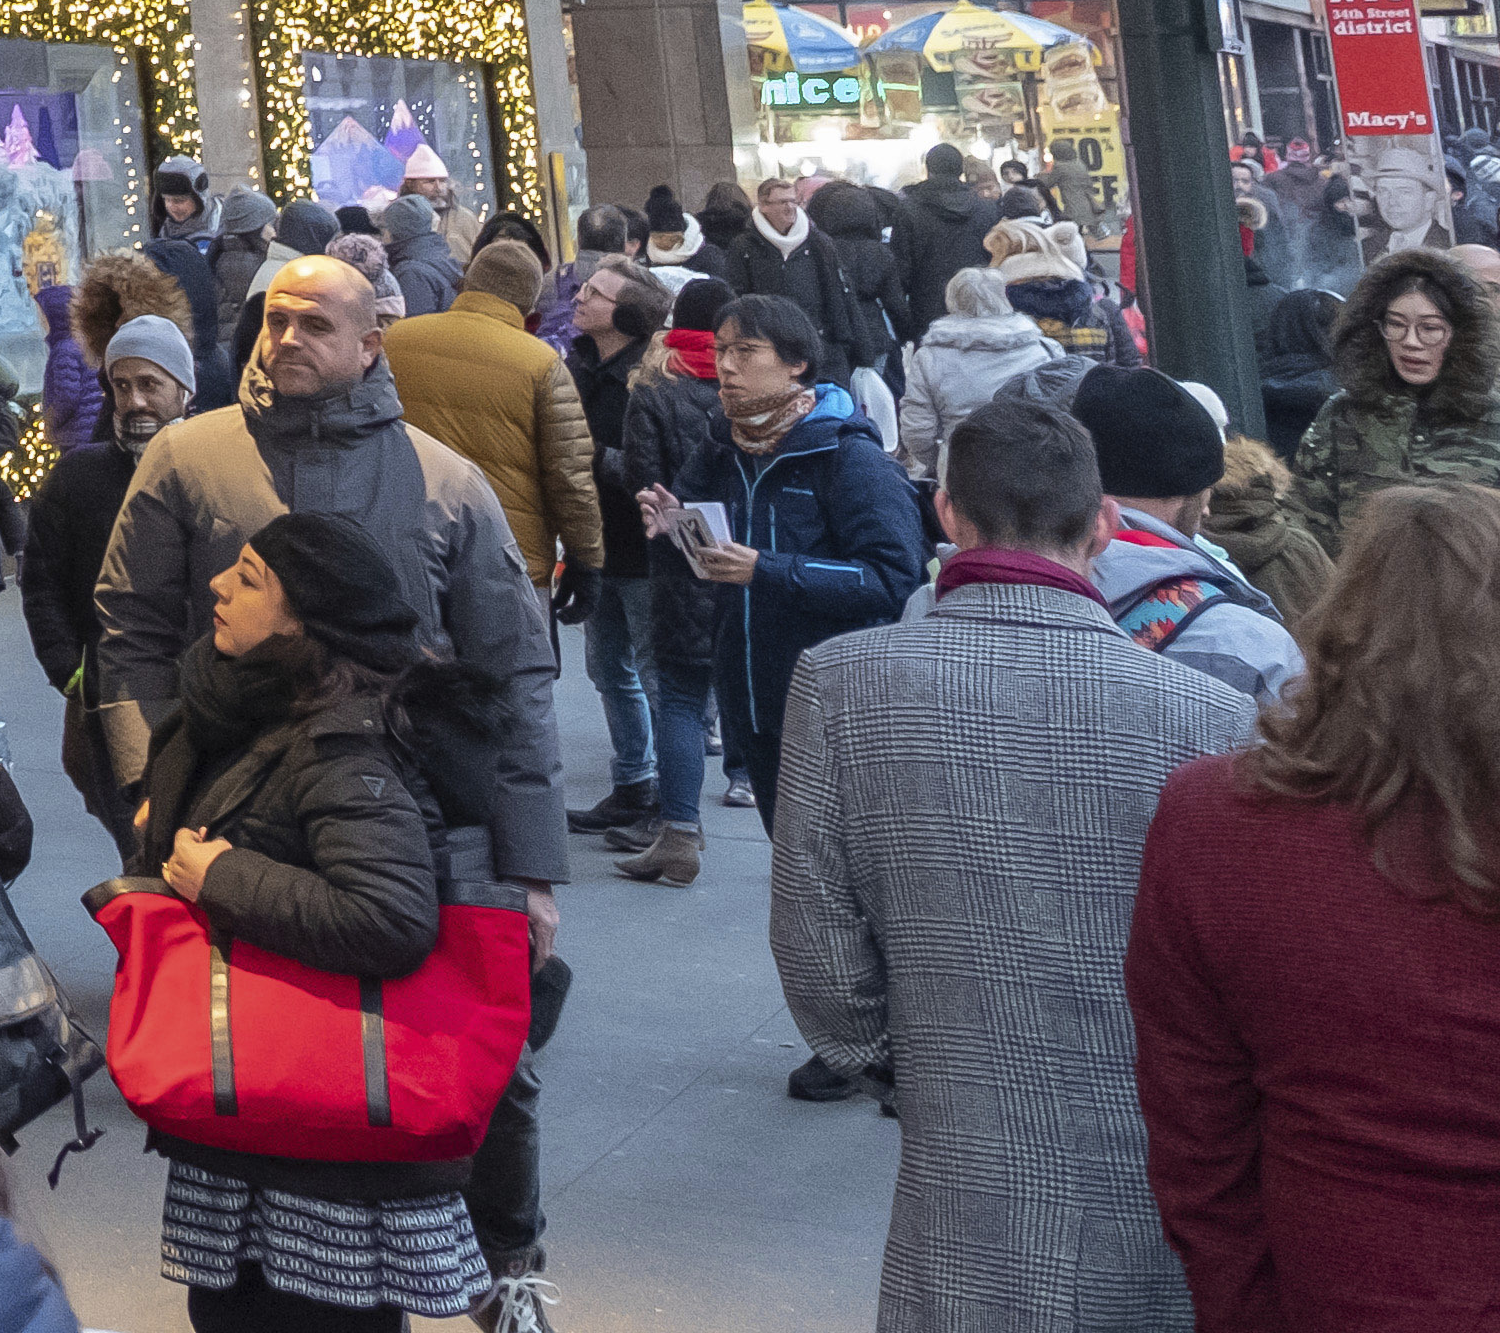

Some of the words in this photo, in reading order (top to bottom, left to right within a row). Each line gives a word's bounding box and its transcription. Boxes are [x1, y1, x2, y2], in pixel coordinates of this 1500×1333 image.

[1333, 9, 1364, 20] 34th
[1367, 8, 1410, 19] Street
[1334, 20, 1413, 35] district
[1348, 111, 1426, 129] Macy's
